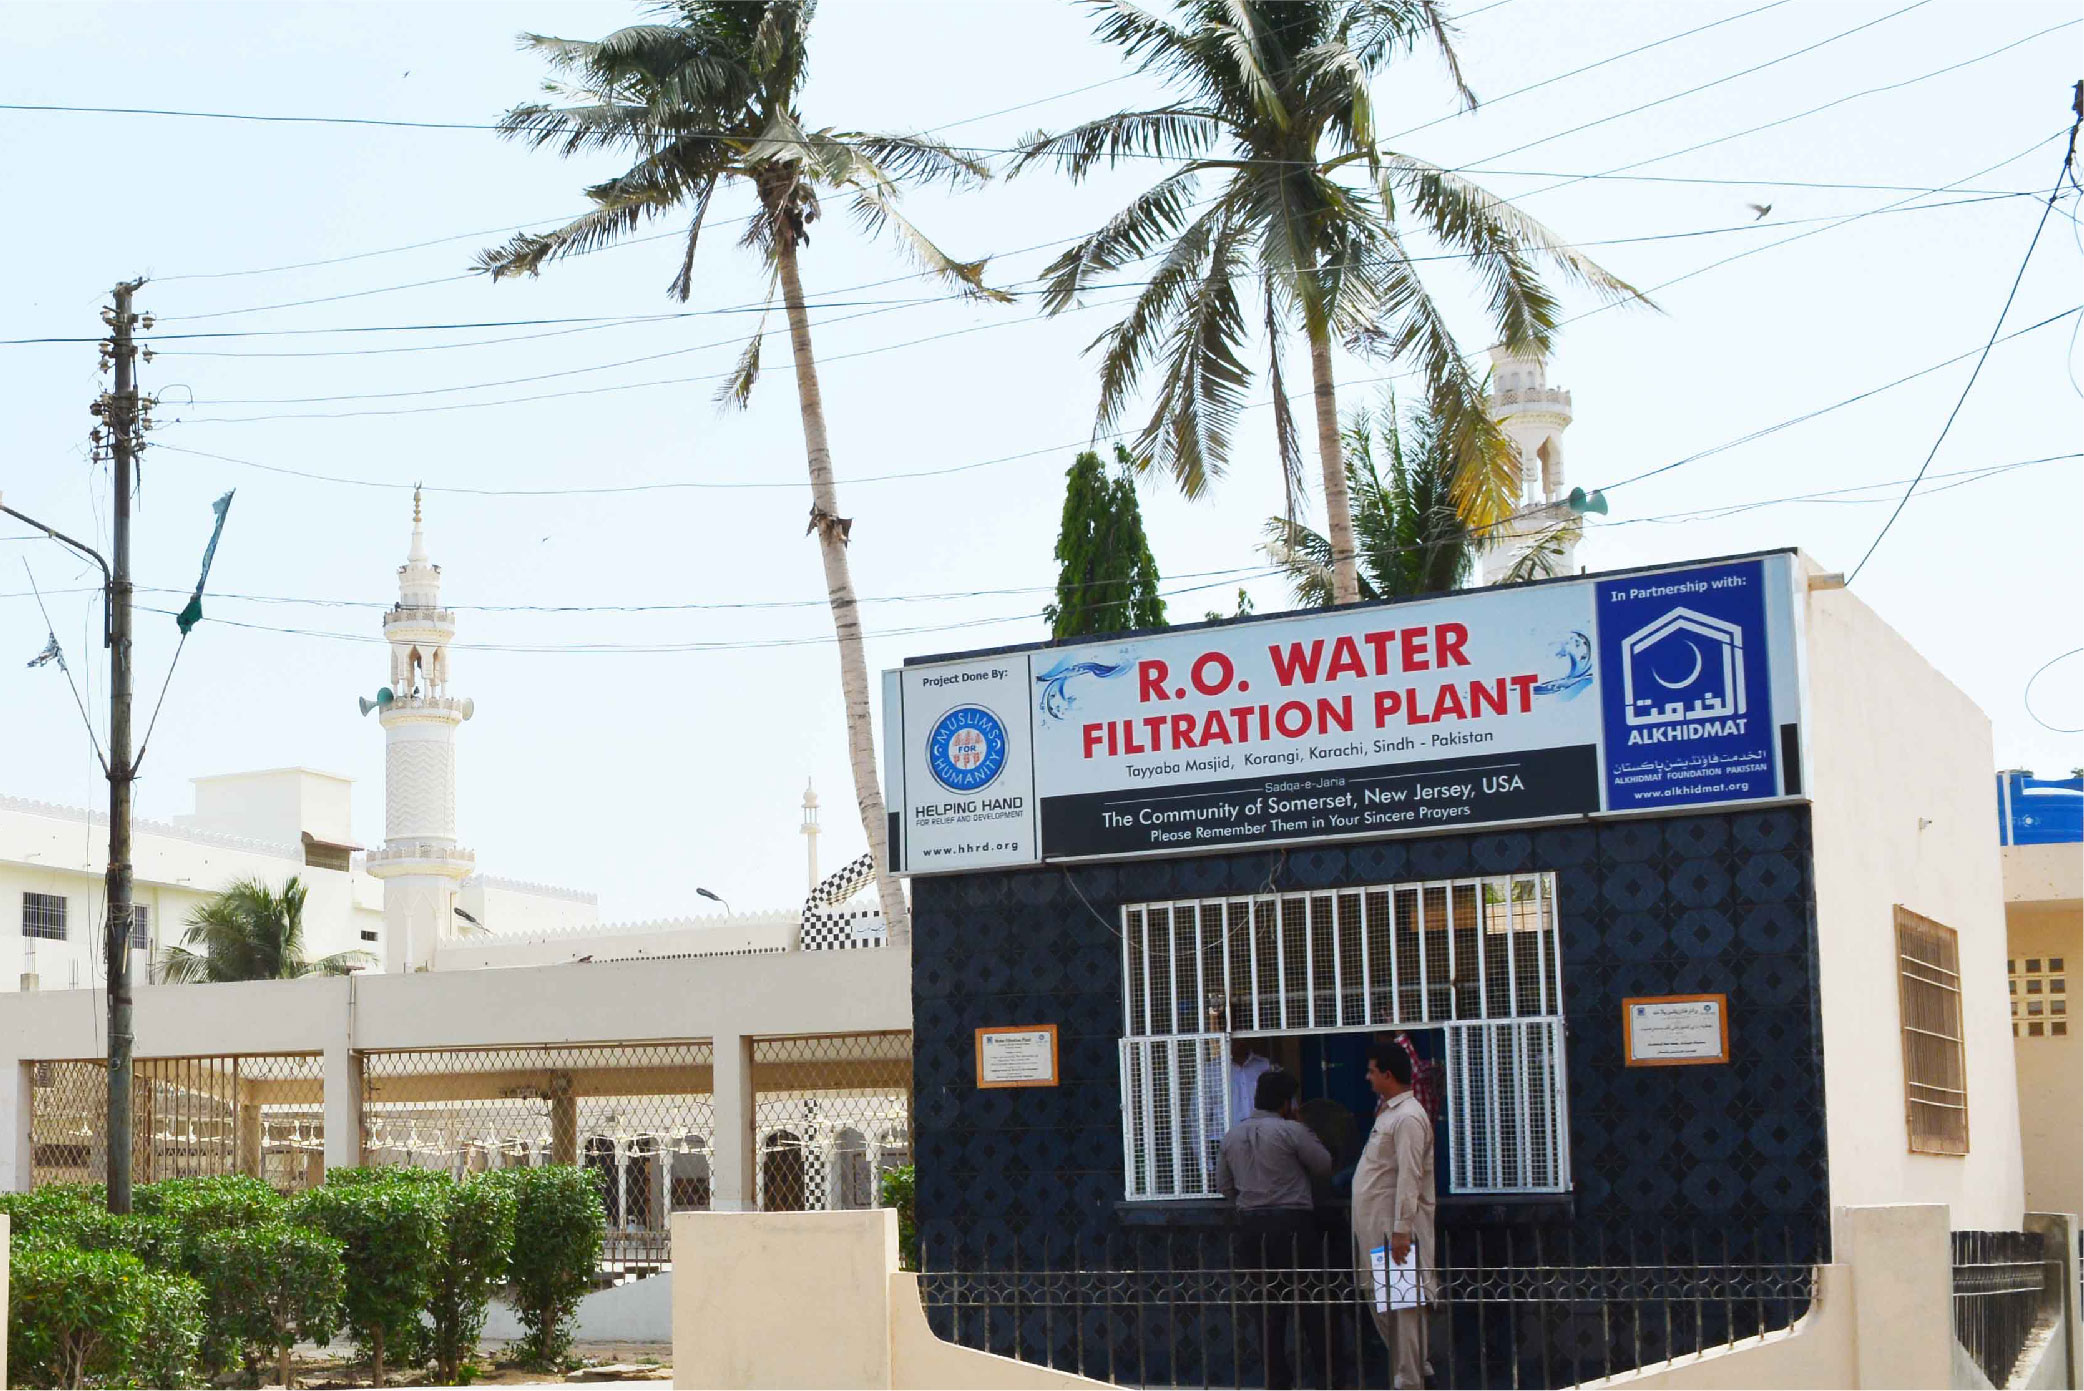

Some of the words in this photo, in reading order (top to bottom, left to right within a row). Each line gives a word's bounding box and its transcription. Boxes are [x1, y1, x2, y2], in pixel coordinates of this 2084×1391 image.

[1611, 591, 1626, 602] In
[1630, 581, 1707, 599] Partnership
[1711, 576, 1747, 589] with:
[1138, 651, 1249, 703] R.O.
[1268, 622, 1471, 687] WATER
[923, 674, 960, 687] Project
[961, 671, 989, 682] Done
[991, 669, 1008, 679] By:
[936, 711, 999, 743] MUSLIMS
[1083, 695, 1353, 758] FILTRATION
[1374, 674, 1538, 728] PLANT
[1627, 719, 1747, 745] ALKHIDMAT
[958, 745, 976, 753] FOR
[1126, 762, 1180, 779] Tayyaba
[1185, 756, 1234, 772] Masjid,
[1244, 748, 1304, 765] Korangi,
[1309, 742, 1368, 760] Karachi,
[1373, 736, 1414, 753] Sindh
[1431, 731, 1494, 747] Pakistan
[934, 752, 1000, 784] HUMANITY
[1614, 773, 1662, 784] ALKHIDMAT
[1667, 768, 1722, 780] FOUNDATION
[1726, 763, 1767, 774] PAKISTAN
[1102, 812, 1133, 828] The
[1139, 803, 1239, 824] Community
[1245, 798, 1263, 815] of
[1268, 792, 1357, 814] Somerset,
[1364, 788, 1408, 805] New
[1413, 783, 1475, 800] Jersey,
[1482, 774, 1524, 794] USA
[1634, 783, 1749, 799] www.alkhidmat.org
[915, 801, 976, 818] HELPING
[982, 797, 1023, 811] HAND
[916, 818, 929, 826] FOR
[932, 816, 955, 825] RELIEF
[957, 815, 971, 823] AND
[973, 810, 1023, 821] DEVELOPMENT
[1151, 830, 1192, 842] Please
[1196, 823, 1266, 839] Remember
[1270, 819, 1307, 832] Them
[1312, 816, 1325, 828] in
[1329, 814, 1360, 827] Your
[1364, 811, 1415, 824] Sincere
[1419, 806, 1471, 820] Prayers
[923, 842, 1019, 856] www.hhrd.org
